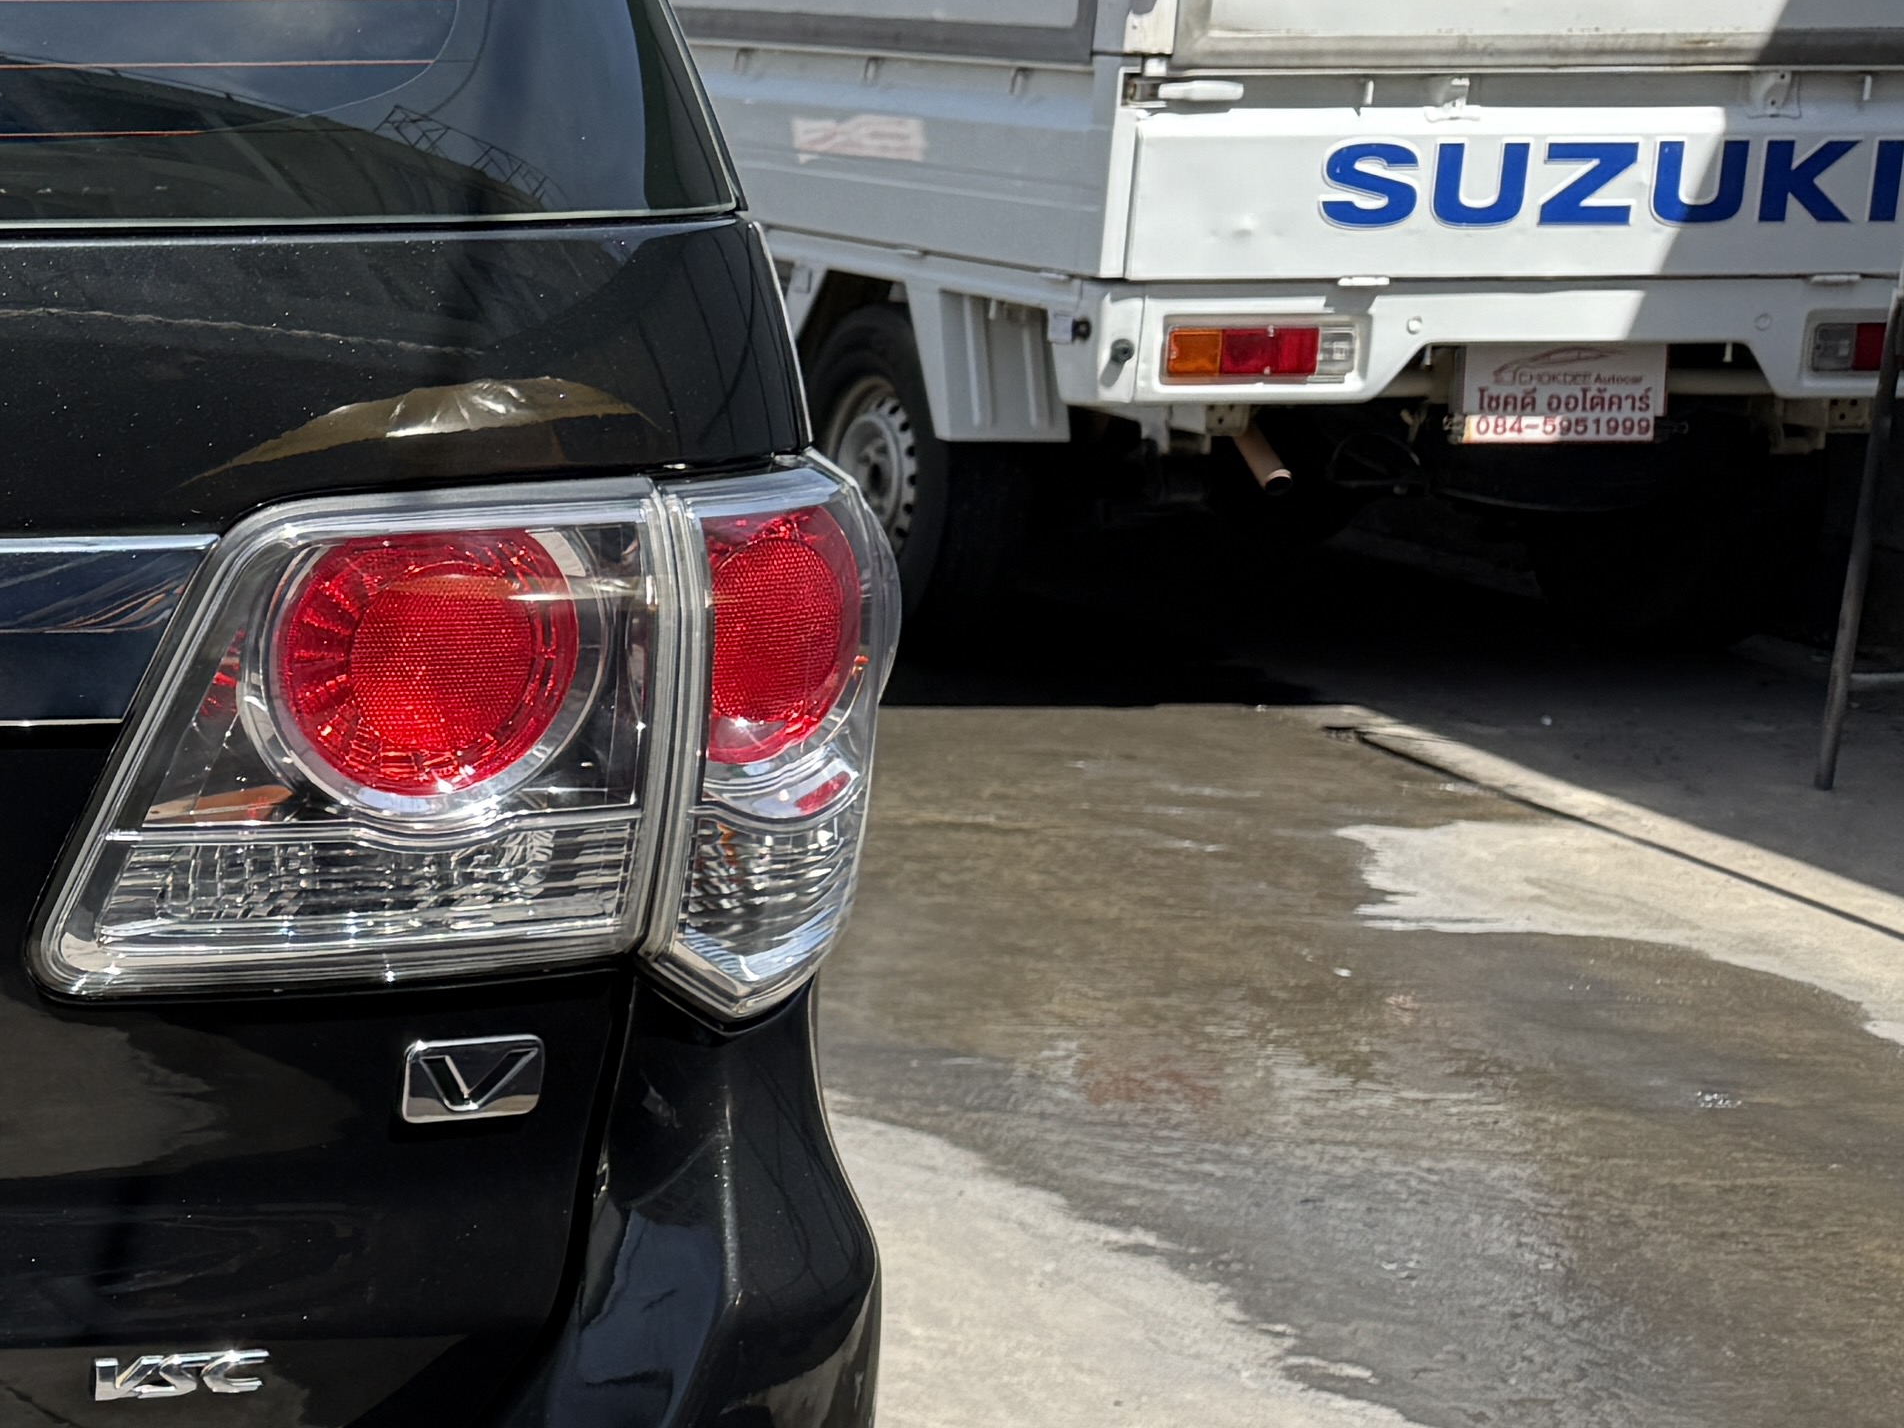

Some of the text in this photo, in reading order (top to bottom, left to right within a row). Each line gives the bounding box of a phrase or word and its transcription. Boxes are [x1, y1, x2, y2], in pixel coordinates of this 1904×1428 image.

[1320, 139, 1903, 229] SUZUKI
[1477, 387, 1653, 413] โชคดี ออโต้คาร์
[1476, 416, 1651, 436] 084-5951999
[94, 1348, 271, 1401] VSC
